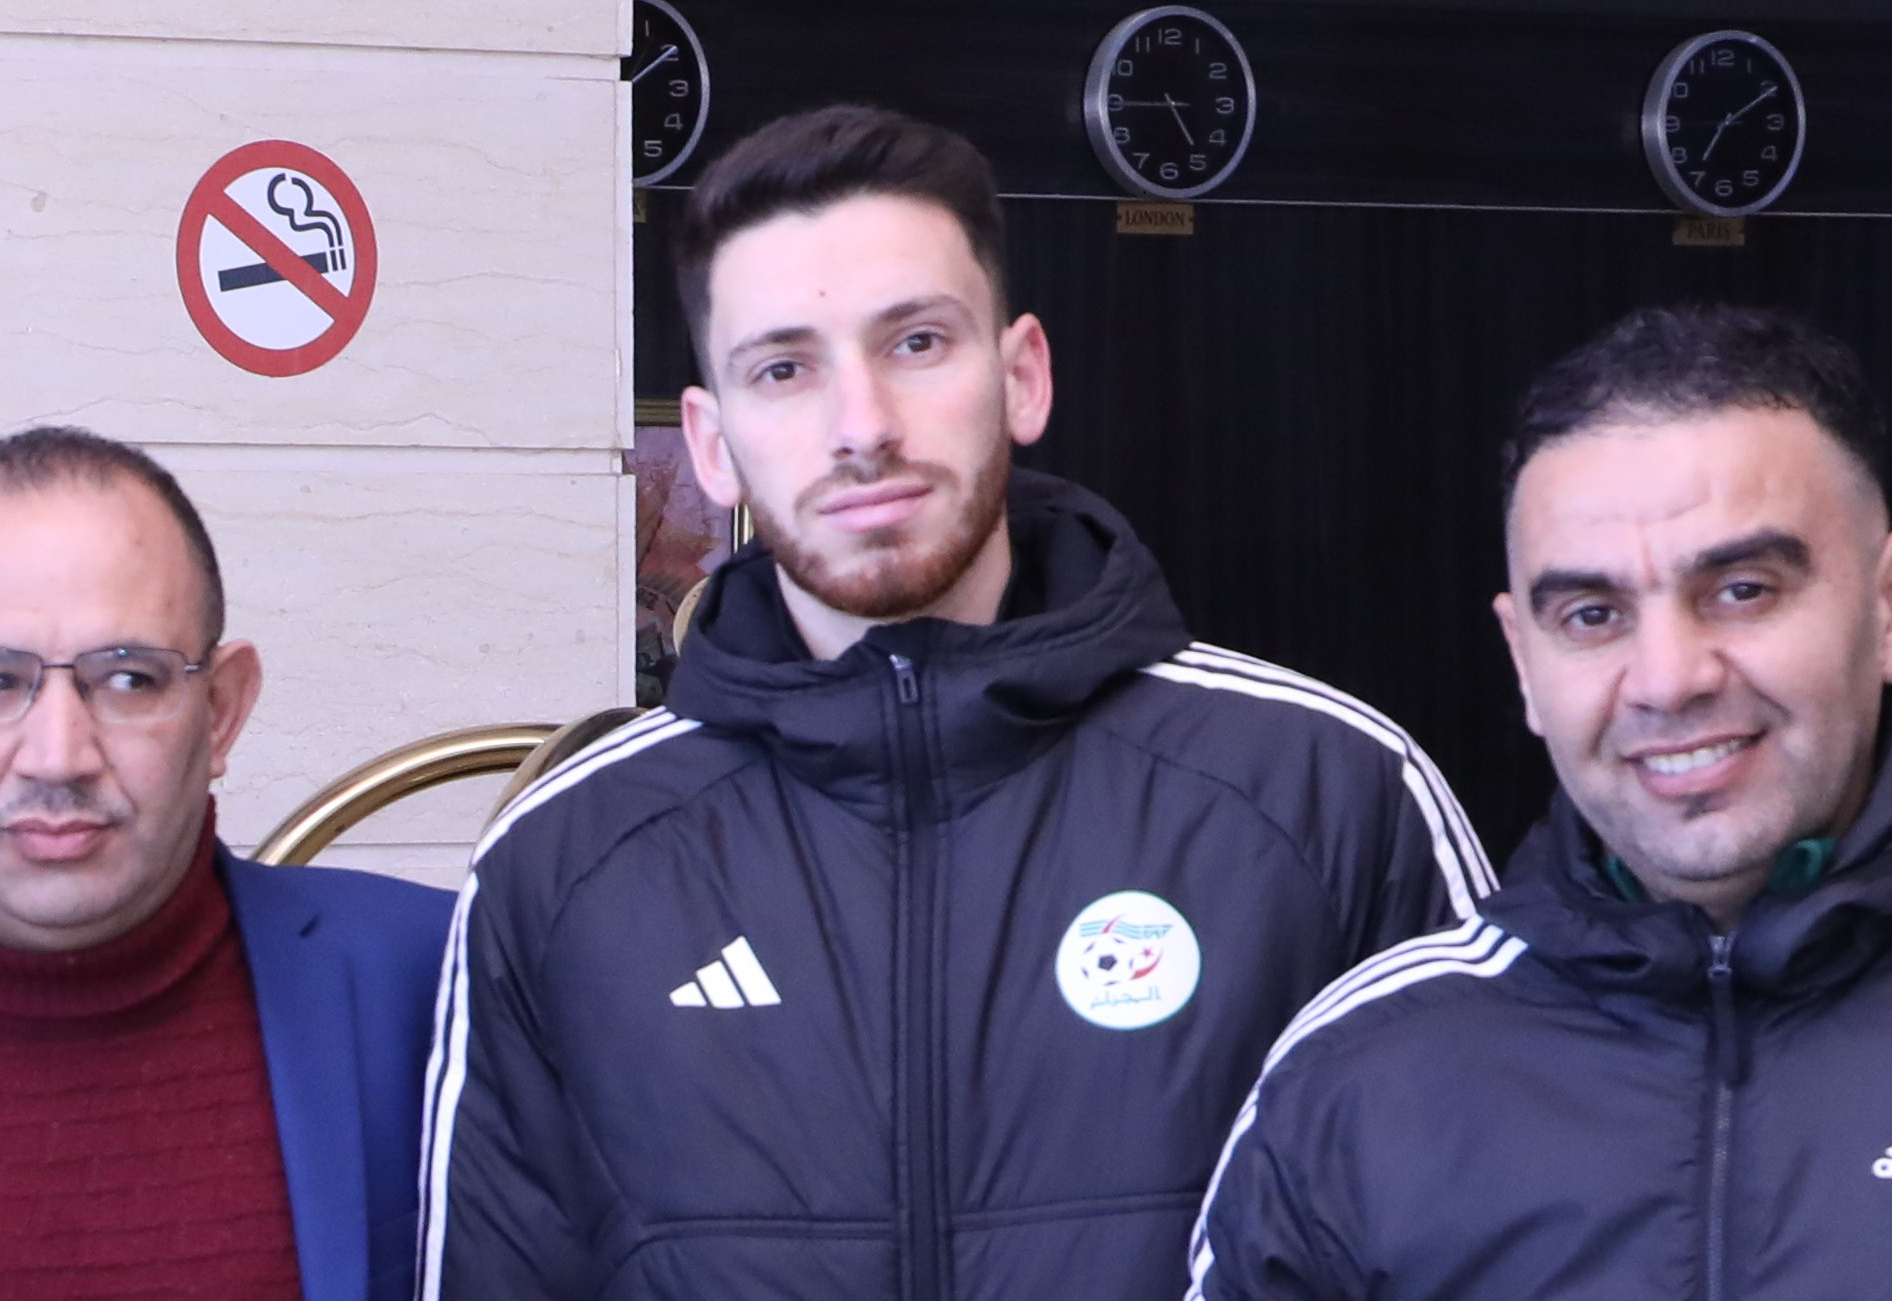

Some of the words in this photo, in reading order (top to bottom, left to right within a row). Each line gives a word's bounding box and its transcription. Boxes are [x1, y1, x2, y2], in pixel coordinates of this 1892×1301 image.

[644, 20, 650, 37] 1
[1158, 28, 1183, 46] 12
[1135, 36, 1150, 53] 11
[1195, 38, 1201, 54] 1
[1711, 49, 1735, 66] 12
[1112, 59, 1133, 77] 0
[1208, 62, 1228, 79] 2
[1690, 59, 1705, 75] 11
[668, 79, 689, 97] 3
[1215, 97, 1235, 114] 3
[664, 113, 683, 131] 4
[1665, 115, 1680, 133] 9
[1766, 114, 1785, 131] 3
[1113, 127, 1130, 144] 8
[1208, 129, 1227, 146] 4
[643, 140, 663, 158] 5
[1671, 147, 1688, 164] 8
[1761, 145, 1778, 162] 4
[1132, 152, 1150, 169] 7
[1189, 154, 1207, 171] 5
[1159, 162, 1179, 180] 6
[1689, 171, 1706, 187] 7
[1743, 170, 1760, 187] 5
[1715, 180, 1733, 197] 6
[1125, 209, 1185, 227] LONDON
[1687, 220, 1731, 239] PARIS
